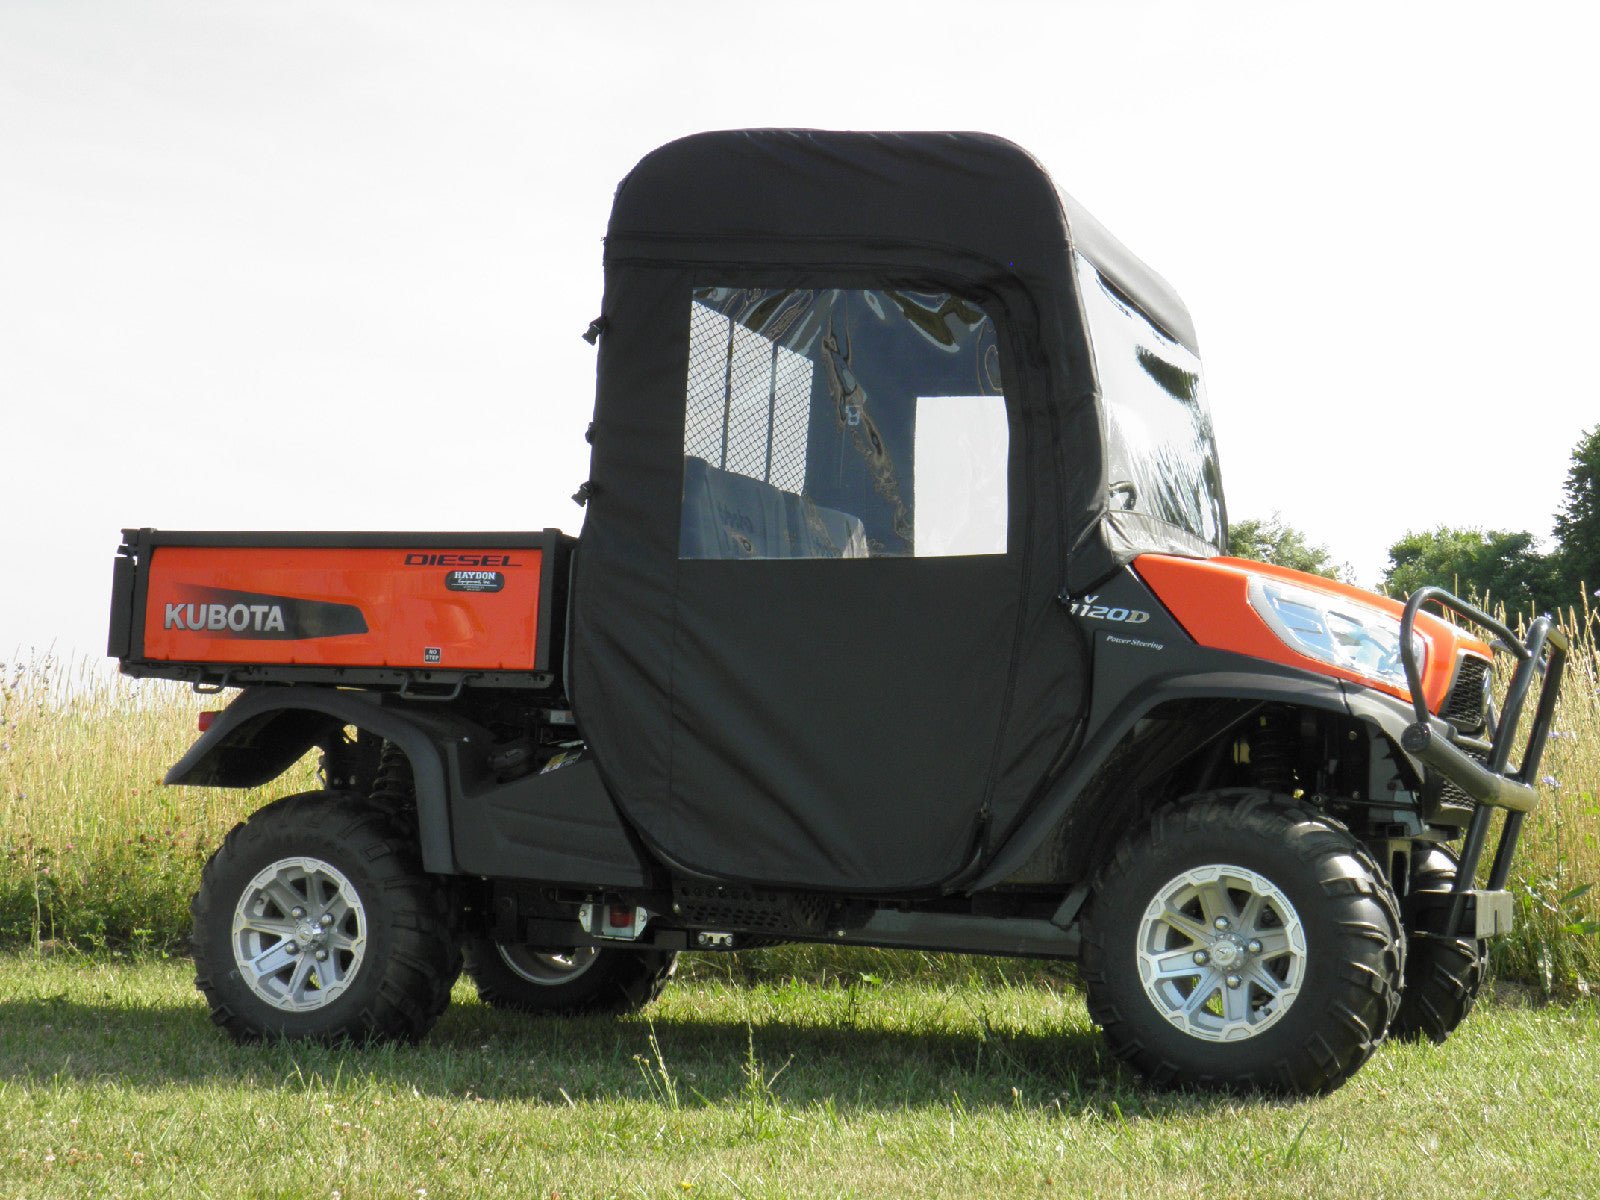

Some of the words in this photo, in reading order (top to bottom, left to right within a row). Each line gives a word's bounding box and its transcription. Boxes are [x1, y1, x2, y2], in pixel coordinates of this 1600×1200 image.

[404, 554, 522, 566] DIESEL
[454, 571, 496, 580] HAYDON
[165, 603, 285, 631] KUBOTA
[1106, 635, 1132, 644] Power
[1131, 639, 1163, 650] Steering
